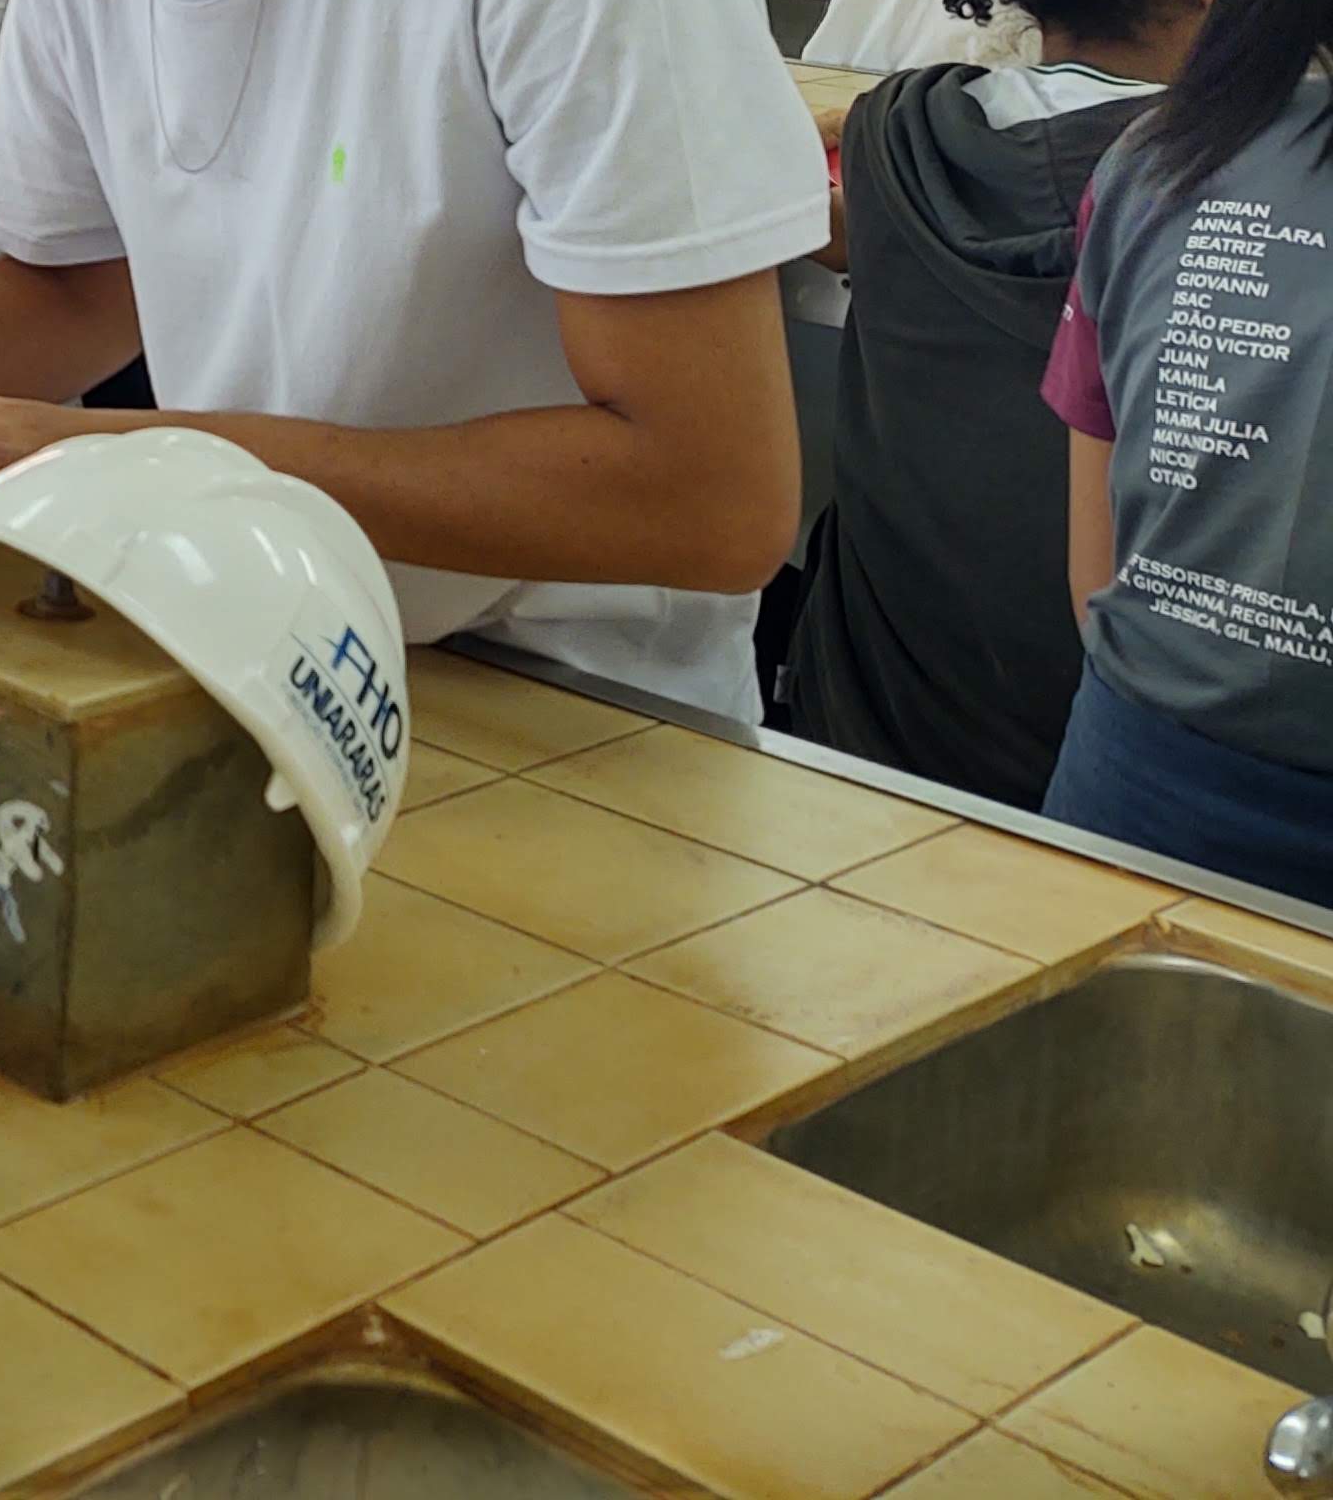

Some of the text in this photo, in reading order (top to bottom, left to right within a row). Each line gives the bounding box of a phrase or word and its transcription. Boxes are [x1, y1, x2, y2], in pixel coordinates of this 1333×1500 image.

[1196, 200, 1271, 219] ADRIAN
[1190, 218, 1326, 248] ANNA CLARA
[1186, 236, 1267, 257] BEATRIZ
[1179, 253, 1264, 277] GABRIEL
[1176, 272, 1270, 298] GIOVANNI
[1172, 290, 1213, 309] ISAC
[1166, 310, 1292, 341] JOÃO PEDRO
[1161, 329, 1291, 362] JOÃO VICTOR
[1158, 349, 1209, 370] JUAN
[1158, 368, 1226, 393] KAMILA
[1155, 408, 1270, 443] MARIA JULIA
[330, 625, 402, 760] FHO
